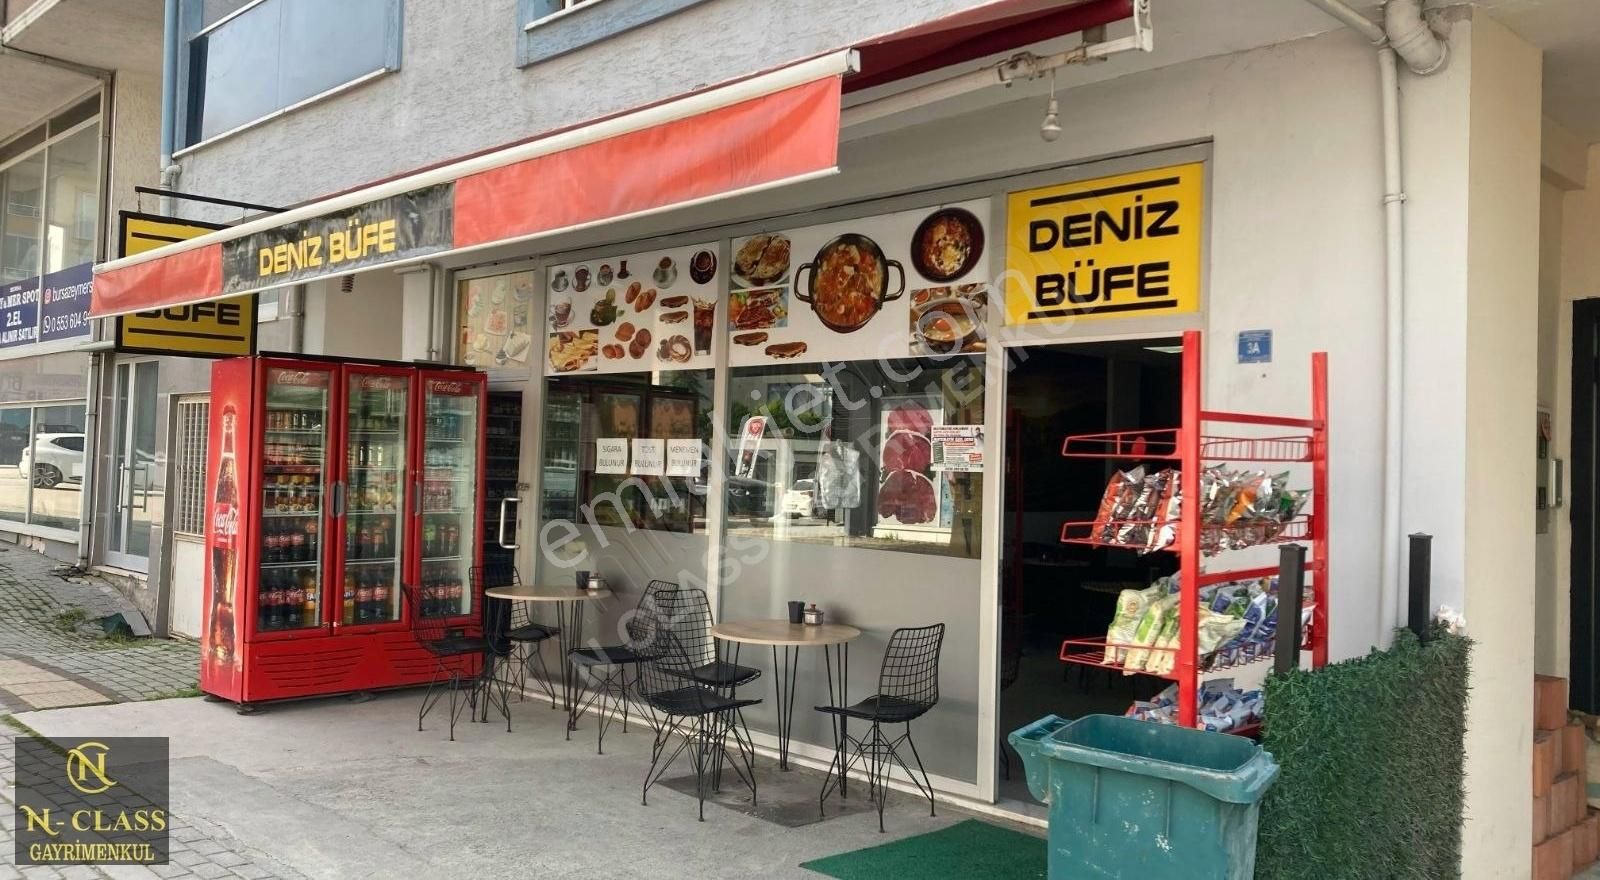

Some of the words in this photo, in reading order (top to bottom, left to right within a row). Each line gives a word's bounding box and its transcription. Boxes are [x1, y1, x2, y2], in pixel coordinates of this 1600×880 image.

[259, 230, 323, 277] DENİZ
[329, 218, 396, 264] BÜFE
[1029, 194, 1179, 253] DENİZ
[1035, 259, 1170, 307] BÜFE
